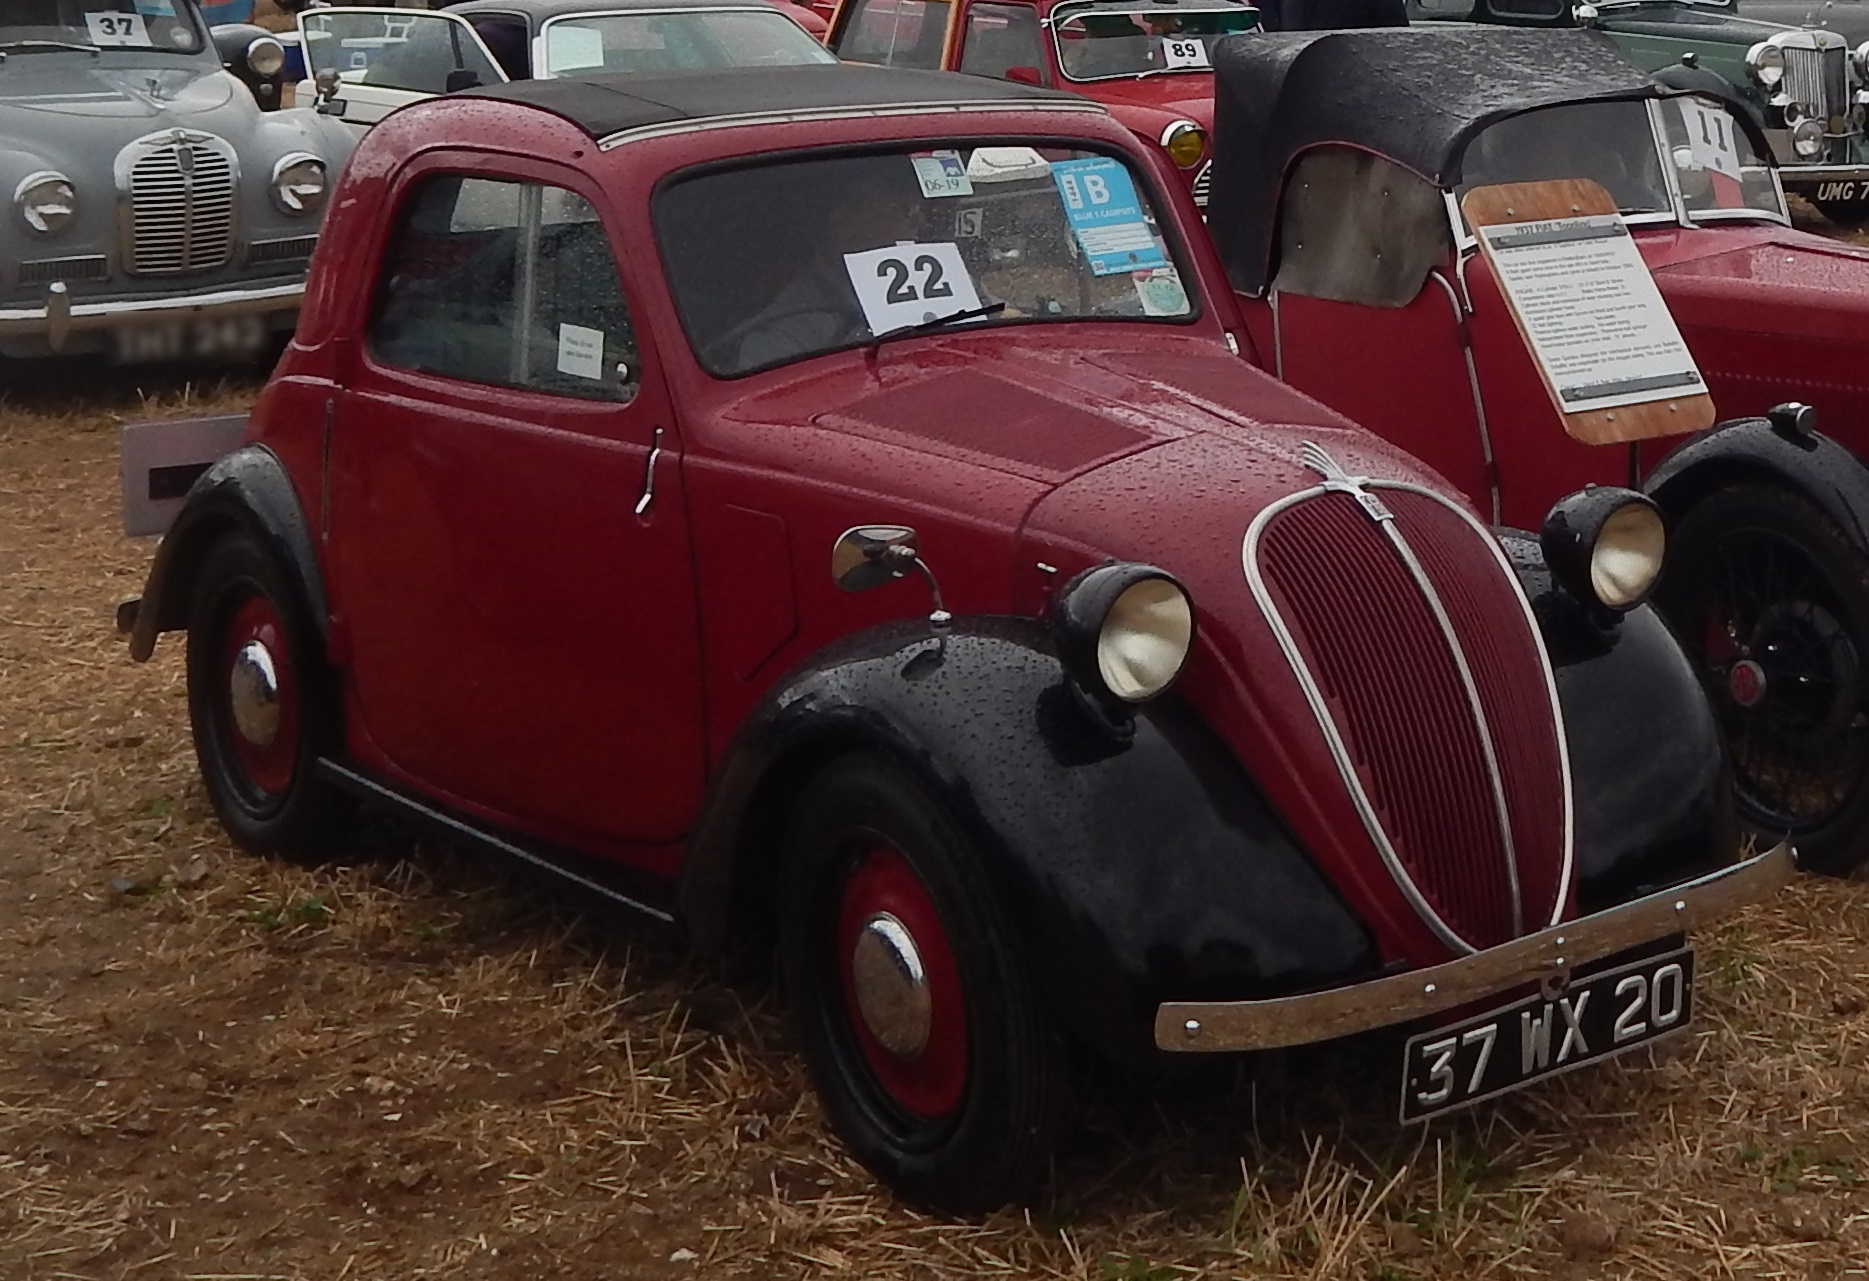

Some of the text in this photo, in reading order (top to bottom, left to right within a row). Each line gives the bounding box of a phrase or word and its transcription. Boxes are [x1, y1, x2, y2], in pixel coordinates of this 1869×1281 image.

[99, 17, 133, 36] 37
[1171, 43, 1197, 58] 89
[1697, 109, 1728, 152] 11
[924, 178, 960, 191] 06-19
[1083, 174, 1110, 205] B
[1817, 181, 1855, 201] UMG
[877, 254, 954, 305] 22
[1417, 963, 1683, 1106] 37 WX 20
